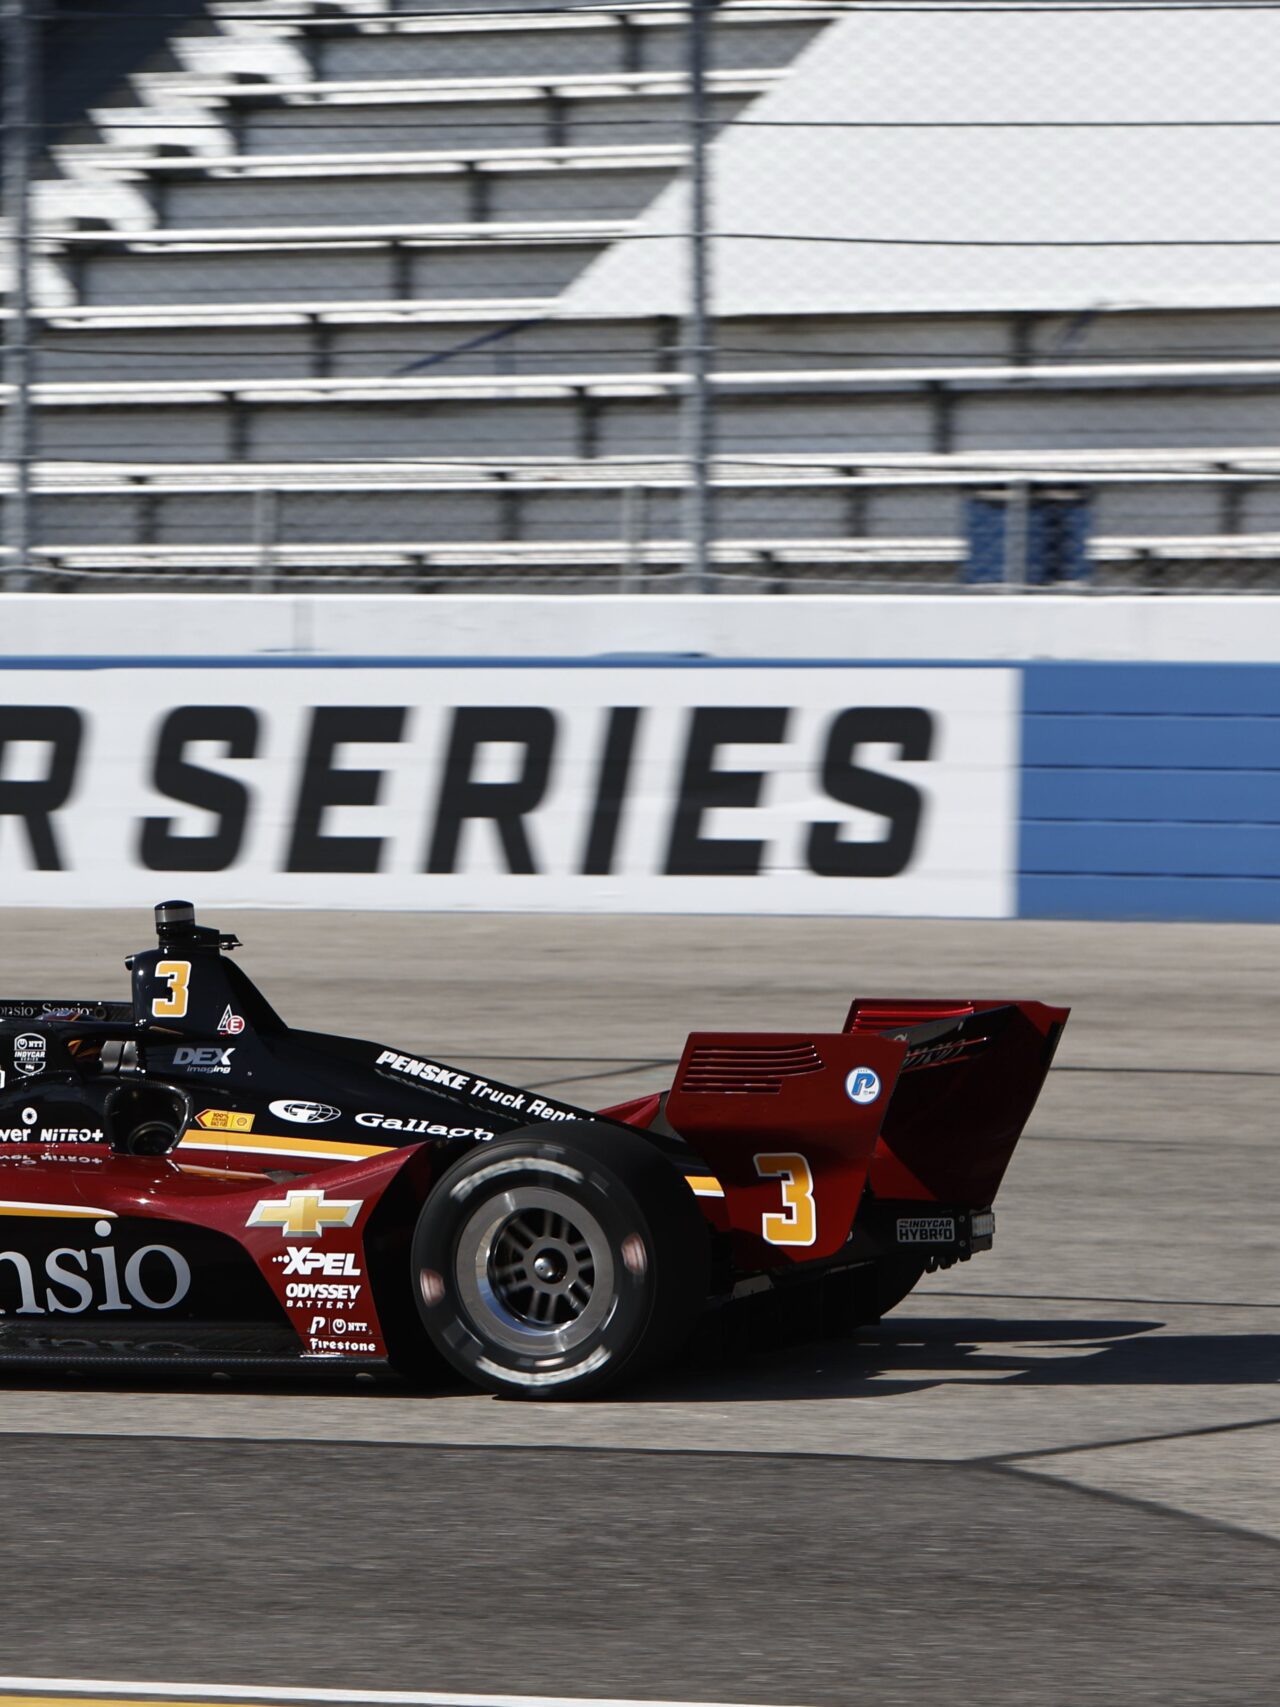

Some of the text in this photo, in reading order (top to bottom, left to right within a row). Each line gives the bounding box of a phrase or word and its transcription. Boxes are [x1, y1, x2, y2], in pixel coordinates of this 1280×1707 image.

[132, 705, 944, 878] SERIES
[151, 960, 192, 1018] 3
[28, 1040, 43, 1048] NTT
[173, 1047, 236, 1065] DEX
[376, 1051, 596, 1121] PENSKE Truck Rent
[355, 1112, 494, 1141] Gallagh
[753, 1152, 816, 1246] 3
[909, 1220, 952, 1228] INDYCAR
[282, 1246, 361, 1276] XPEL
[286, 1283, 361, 1299] ODYSSEY
[286, 1300, 355, 1309] BATTERY
[347, 1322, 368, 1331] NTT
[310, 1338, 376, 1352] Firestone
